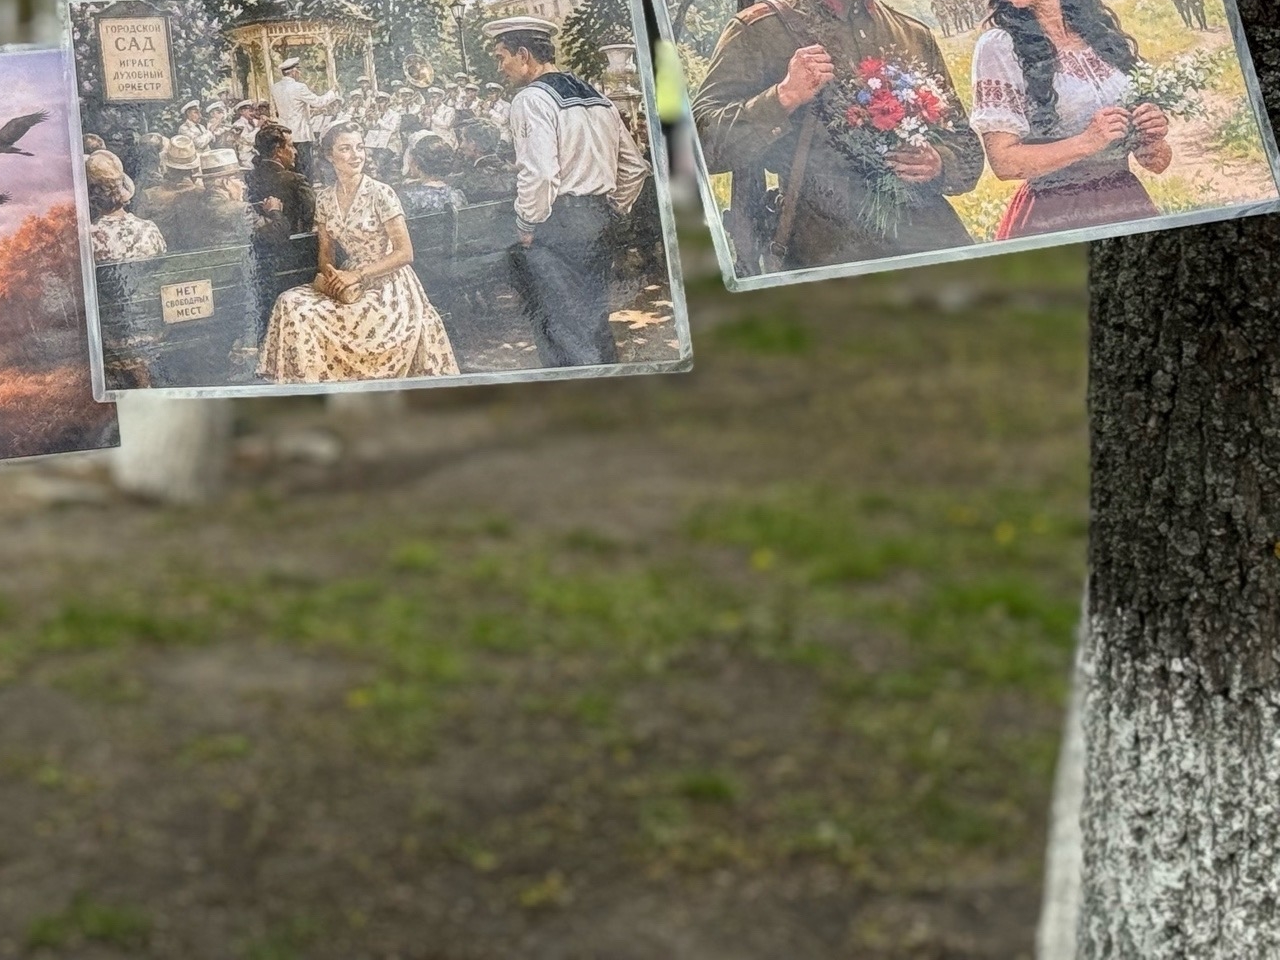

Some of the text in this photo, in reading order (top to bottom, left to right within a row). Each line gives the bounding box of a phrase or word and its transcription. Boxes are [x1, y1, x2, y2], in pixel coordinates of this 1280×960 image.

[114, 36, 156, 53] САД
[119, 58, 155, 68] ИГРАЕТ
[113, 69, 163, 81] ДУХОВНЫЙ
[117, 82, 161, 92] ОРКЕСТР
[175, 285, 197, 296] НЕТ
[176, 306, 201, 317] МЕСТ
